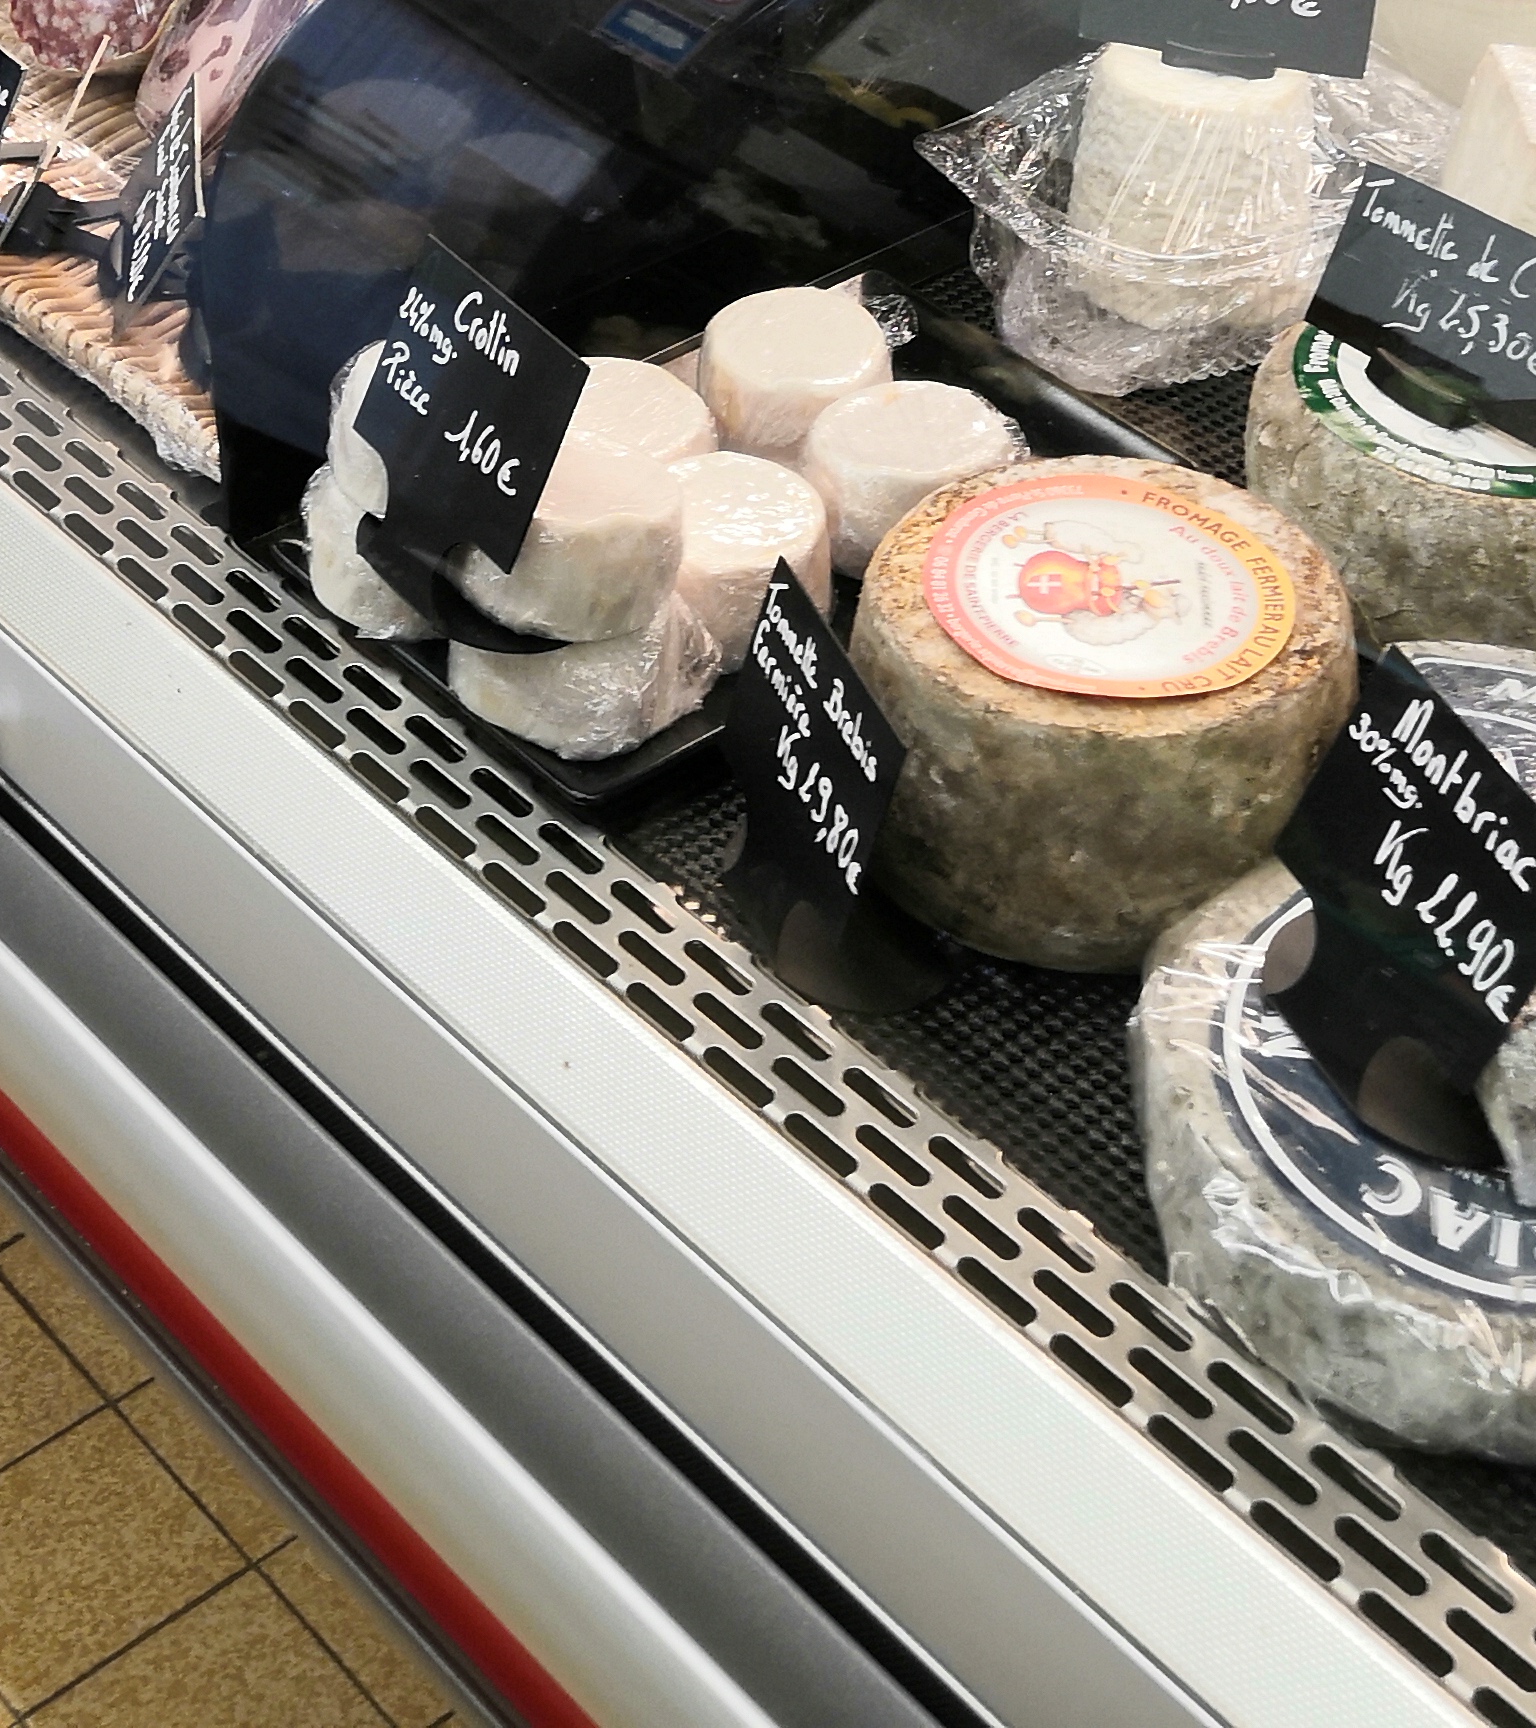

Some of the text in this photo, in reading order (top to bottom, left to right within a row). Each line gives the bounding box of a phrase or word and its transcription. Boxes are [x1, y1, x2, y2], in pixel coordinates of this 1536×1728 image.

[1465, 233, 1500, 284] de
[1381, 268, 1440, 334] Kg
[453, 290, 521, 378] Crottin
[380, 340, 522, 497] Pièce 1,60€
[1168, 522, 1199, 544] Au
[964, 564, 977, 578] DE
[1199, 543, 1233, 579] doux
[1140, 489, 1287, 694] FROMAGE FERMIER AU LAIT CRU
[1228, 578, 1246, 602] lait
[1228, 603, 1250, 624] de
[1180, 625, 1242, 666] Brebis
[776, 724, 801, 791] Kg
[1372, 818, 1431, 907] Kg
